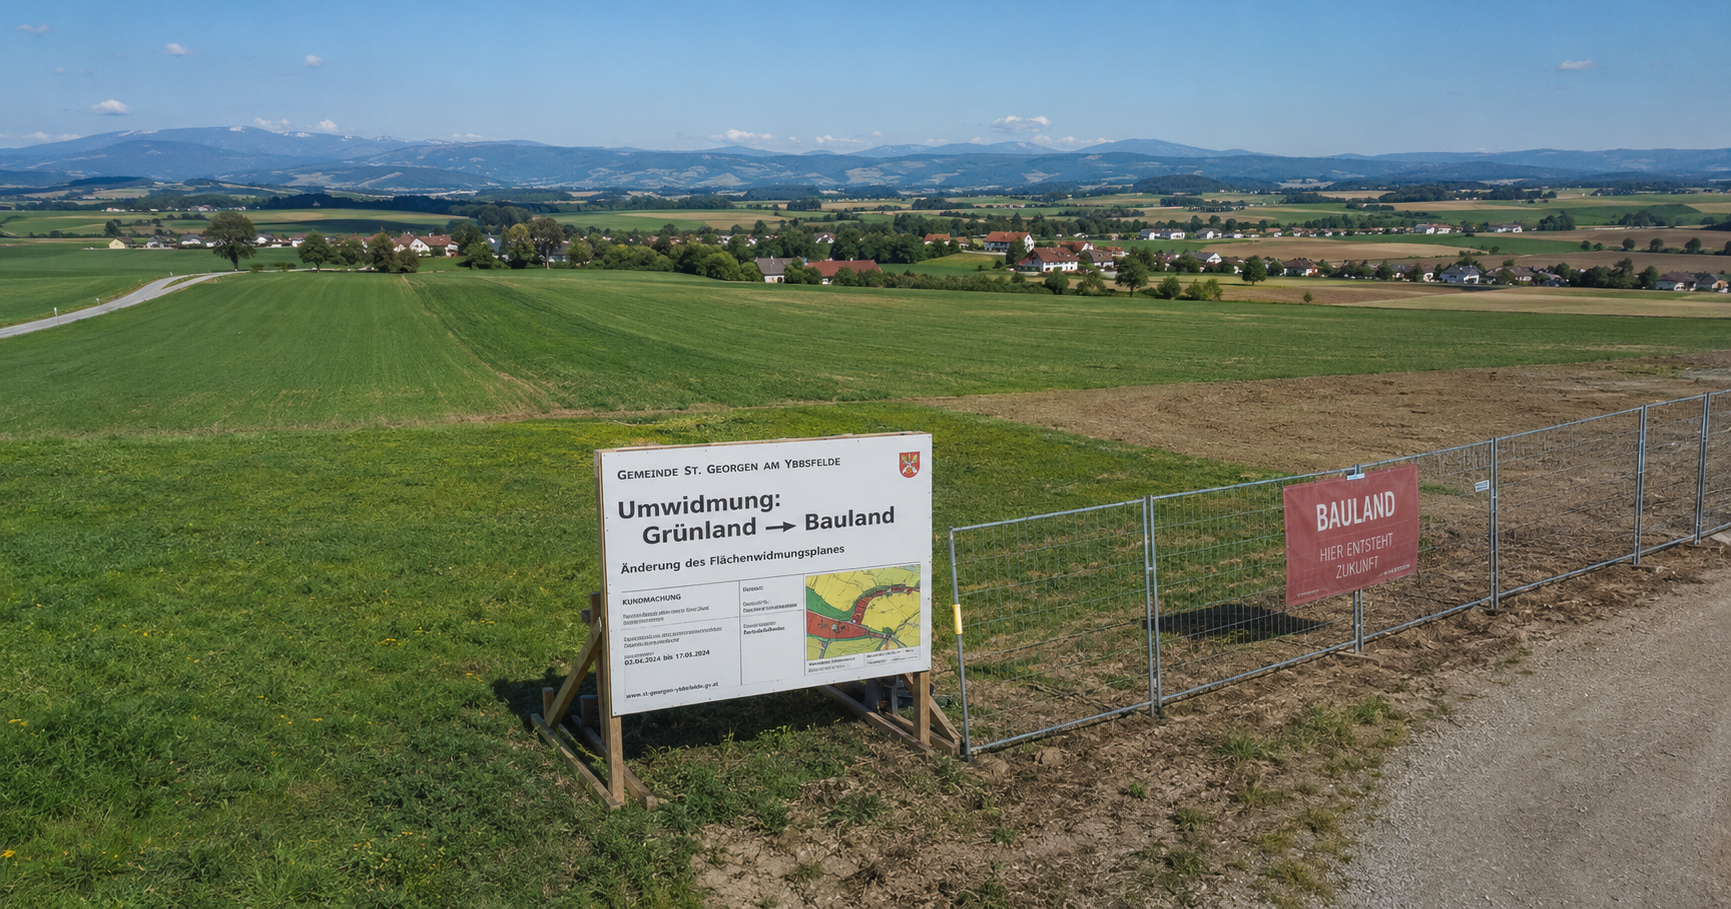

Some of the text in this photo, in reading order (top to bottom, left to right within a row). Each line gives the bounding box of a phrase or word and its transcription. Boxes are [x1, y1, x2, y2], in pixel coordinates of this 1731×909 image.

[618, 468, 678, 480] GEMEINDE
[707, 463, 757, 473] GEORGEN
[785, 458, 840, 468] YBBSFELDE
[618, 494, 781, 520] Umwidmung:
[1316, 491, 1395, 532] BAULAND
[643, 506, 894, 544] Grünland Bauland
[621, 546, 845, 574] Änderung des Flächenwidmungsplanes
[1320, 533, 1393, 562] HIER ENTSTEHT
[1336, 556, 1379, 579] ZUKUNFT
[623, 594, 681, 605] KUNDMACHUNG
